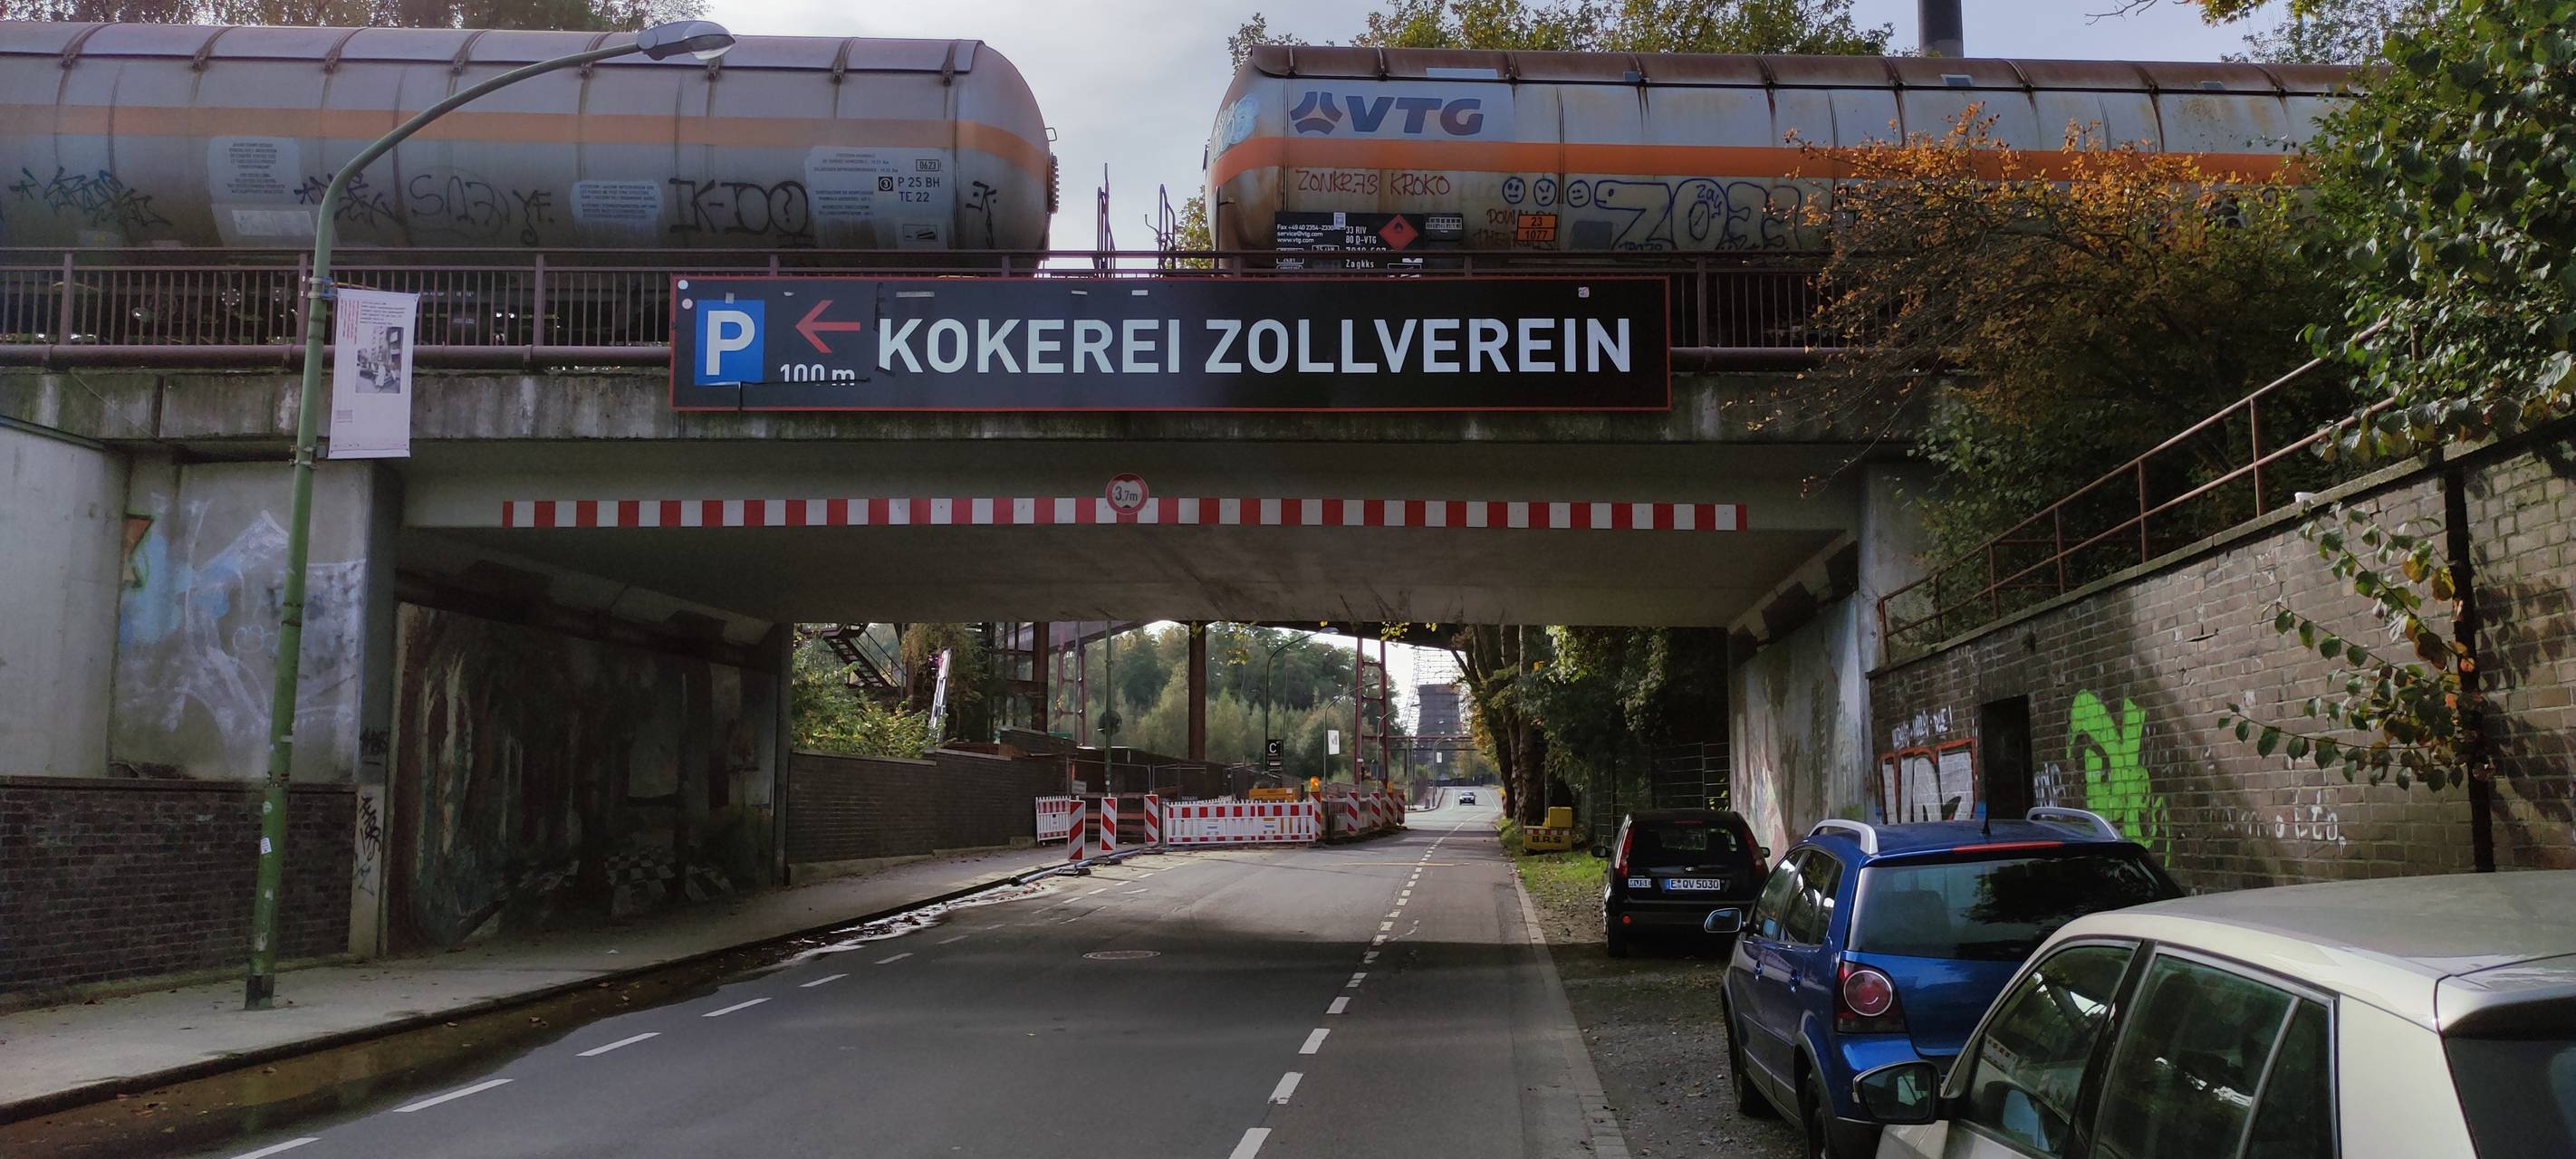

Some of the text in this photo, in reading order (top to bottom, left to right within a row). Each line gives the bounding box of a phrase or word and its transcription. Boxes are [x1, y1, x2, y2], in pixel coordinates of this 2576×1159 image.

[1345, 95, 1484, 136] VTG
[898, 177, 940, 187] P 25 BH
[1389, 173, 1450, 196] KROKO
[899, 191, 930, 203] TE 22
[1531, 217, 1543, 226] 23
[1345, 225, 1367, 235] 33 RIV
[1524, 230, 1548, 240] 1077
[1345, 235, 1377, 244] 80 D-VTG
[1345, 259, 1375, 269] Zagkks
[706, 310, 755, 376] P
[879, 318, 1630, 373] KOKEREI ZOLLVEREIN
[780, 363, 856, 386] 100 m
[1682, 879, 1695, 889] QV
[1696, 879, 1719, 889] 5030
